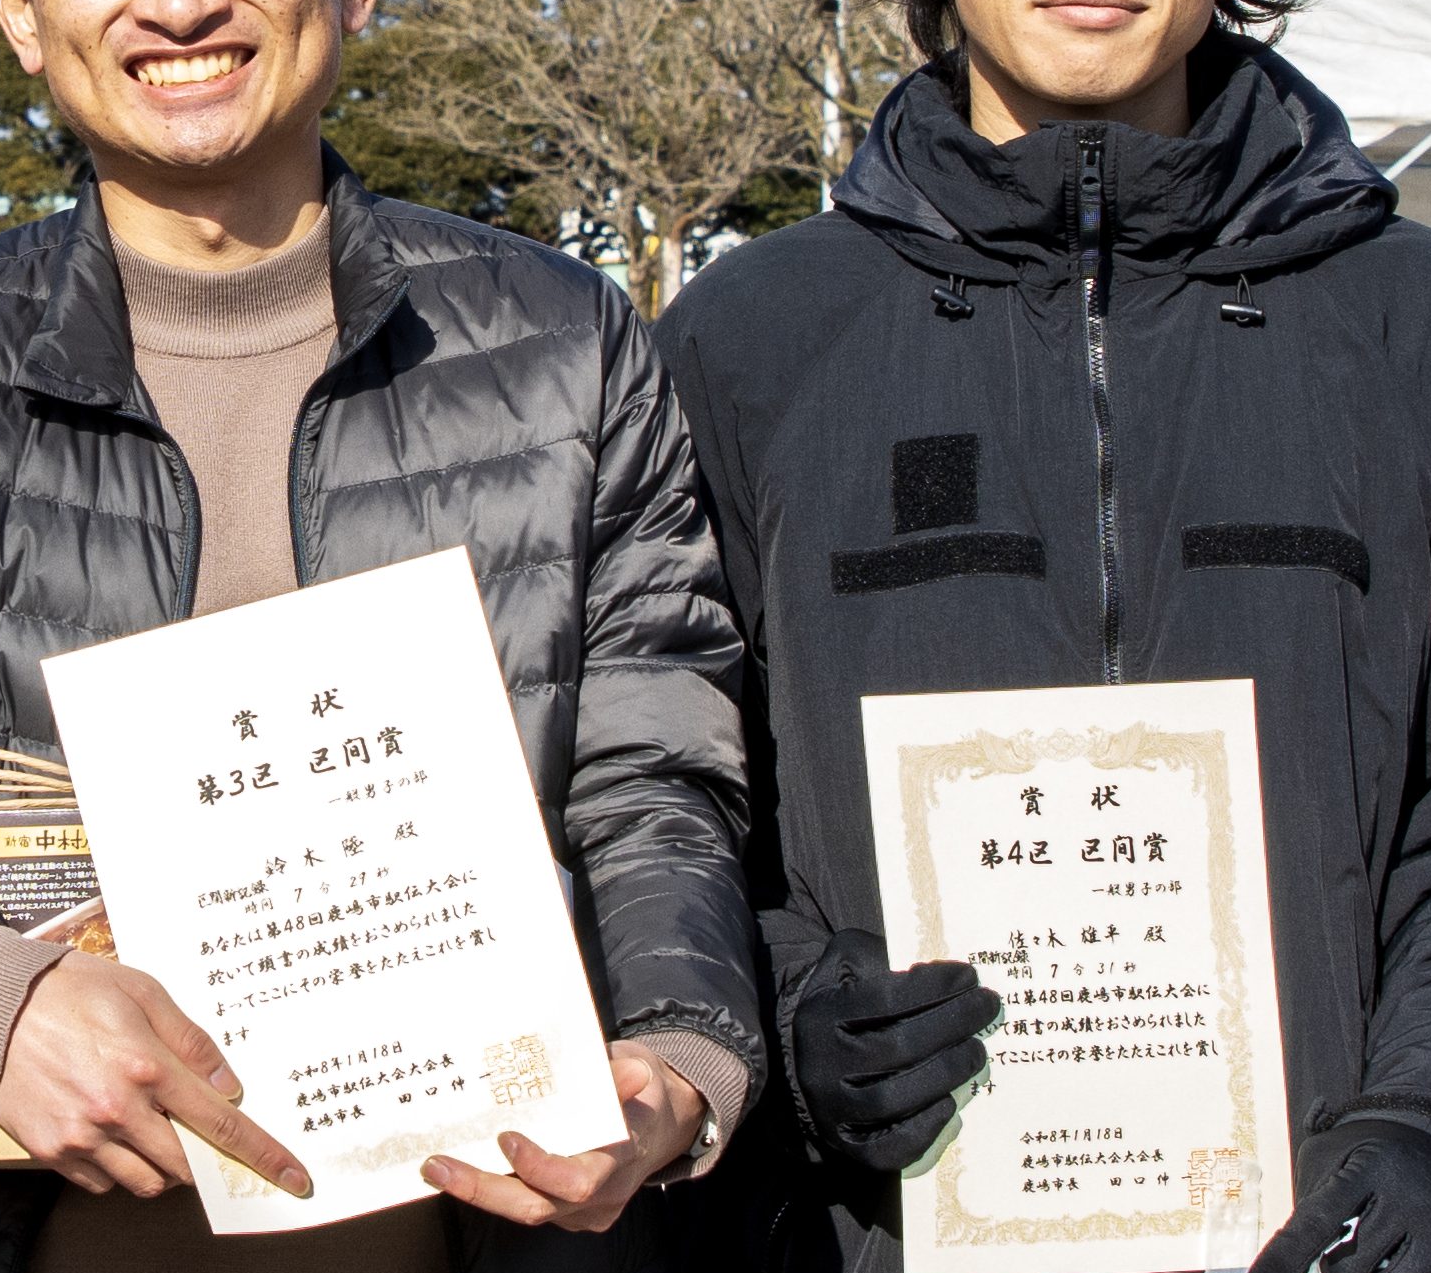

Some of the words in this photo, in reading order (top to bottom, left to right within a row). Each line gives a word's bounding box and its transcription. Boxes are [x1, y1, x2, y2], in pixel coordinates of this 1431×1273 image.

[197, 763, 279, 805] 第3区
[309, 726, 403, 774] 区間賞
[328, 770, 428, 803] 一般男子の部
[36, 829, 88, 851] 中村
[981, 839, 1052, 869] 第4区
[1081, 832, 1168, 864] 区間賞
[1092, 880, 1182, 897] 一般男子の部
[1000, 983, 1211, 1006] は第48回鹿嶋市駅伝大会に
[976, 1012, 1206, 1036] いて頭書の成績をおさめられました
[223, 1026, 249, 1046] ます
[288, 1041, 403, 1082] 令和8年1月18日
[296, 1053, 454, 1108] 鹿嶋市駅伝大会大会長
[970, 1080, 996, 1096] ます
[1019, 1127, 1123, 1145] 令和8年1月18日
[1021, 1148, 1164, 1169] 鹿嶋市駅伝大会大会長
[1022, 1177, 1080, 1193] 鹿嶋市長
